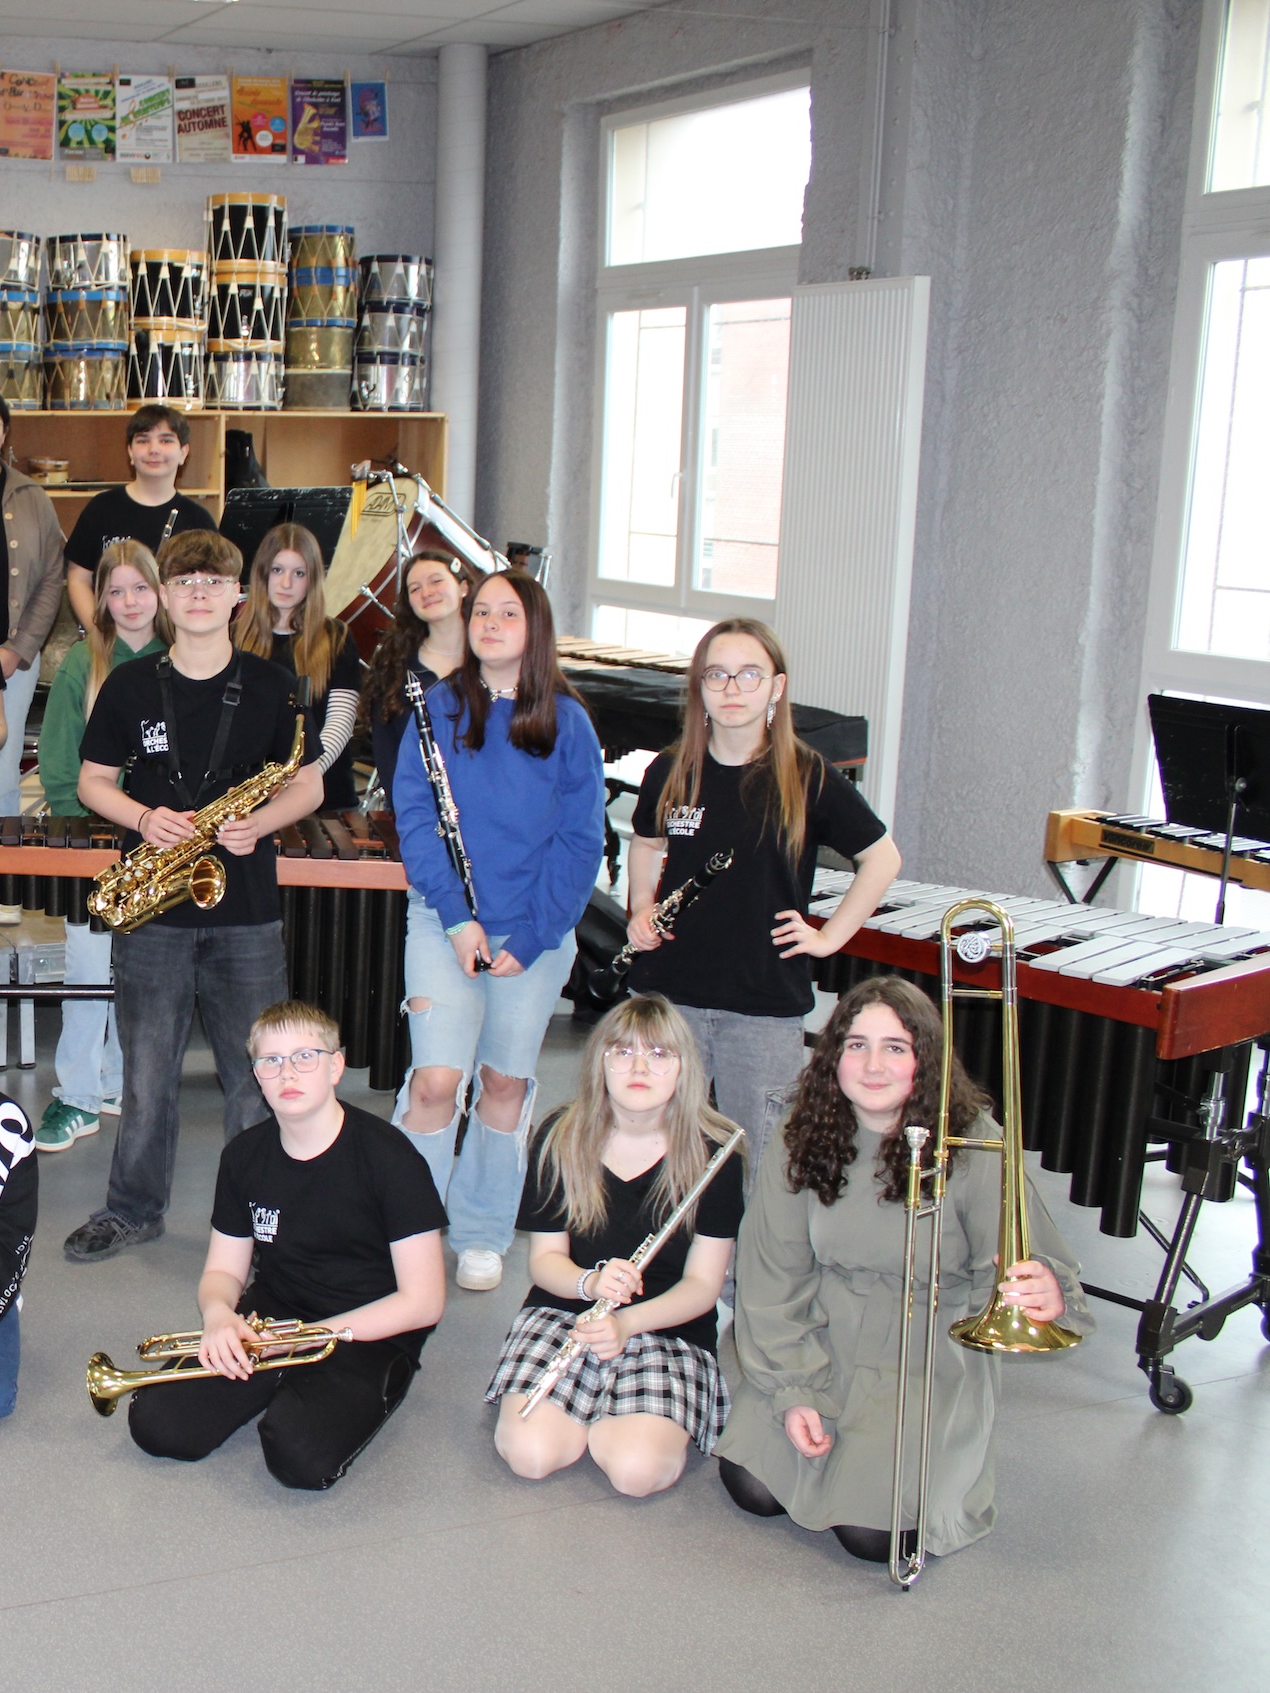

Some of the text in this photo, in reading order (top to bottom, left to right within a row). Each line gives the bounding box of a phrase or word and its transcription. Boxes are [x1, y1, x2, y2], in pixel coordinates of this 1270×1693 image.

[177, 105, 226, 121] CONCERT
[178, 117, 228, 134] AUTOMNE
[142, 737, 169, 748] ORCHES
